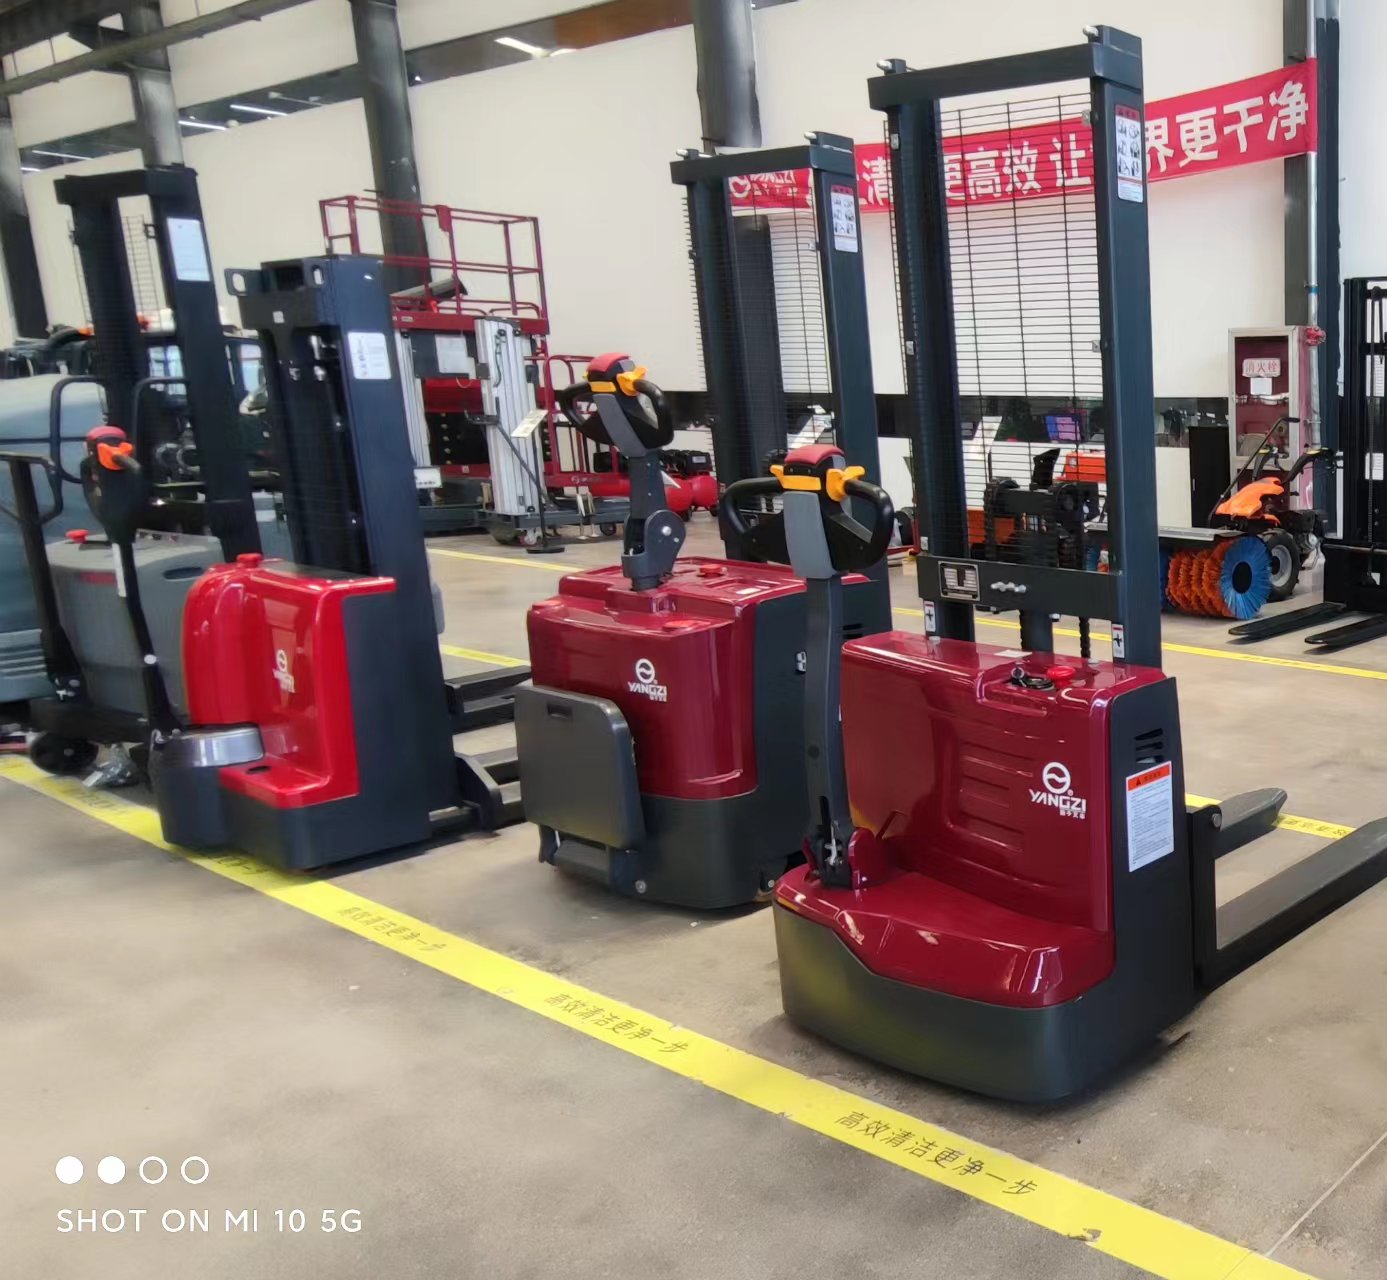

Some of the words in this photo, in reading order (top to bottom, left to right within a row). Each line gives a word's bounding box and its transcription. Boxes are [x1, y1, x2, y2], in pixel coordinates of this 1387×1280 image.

[627, 681, 667, 696] YANGZI
[1029, 788, 1087, 811] YANGZI
[543, 993, 689, 1053] 高效清洁更净一步
[834, 1111, 1038, 1195] 高效清洁更净一步
